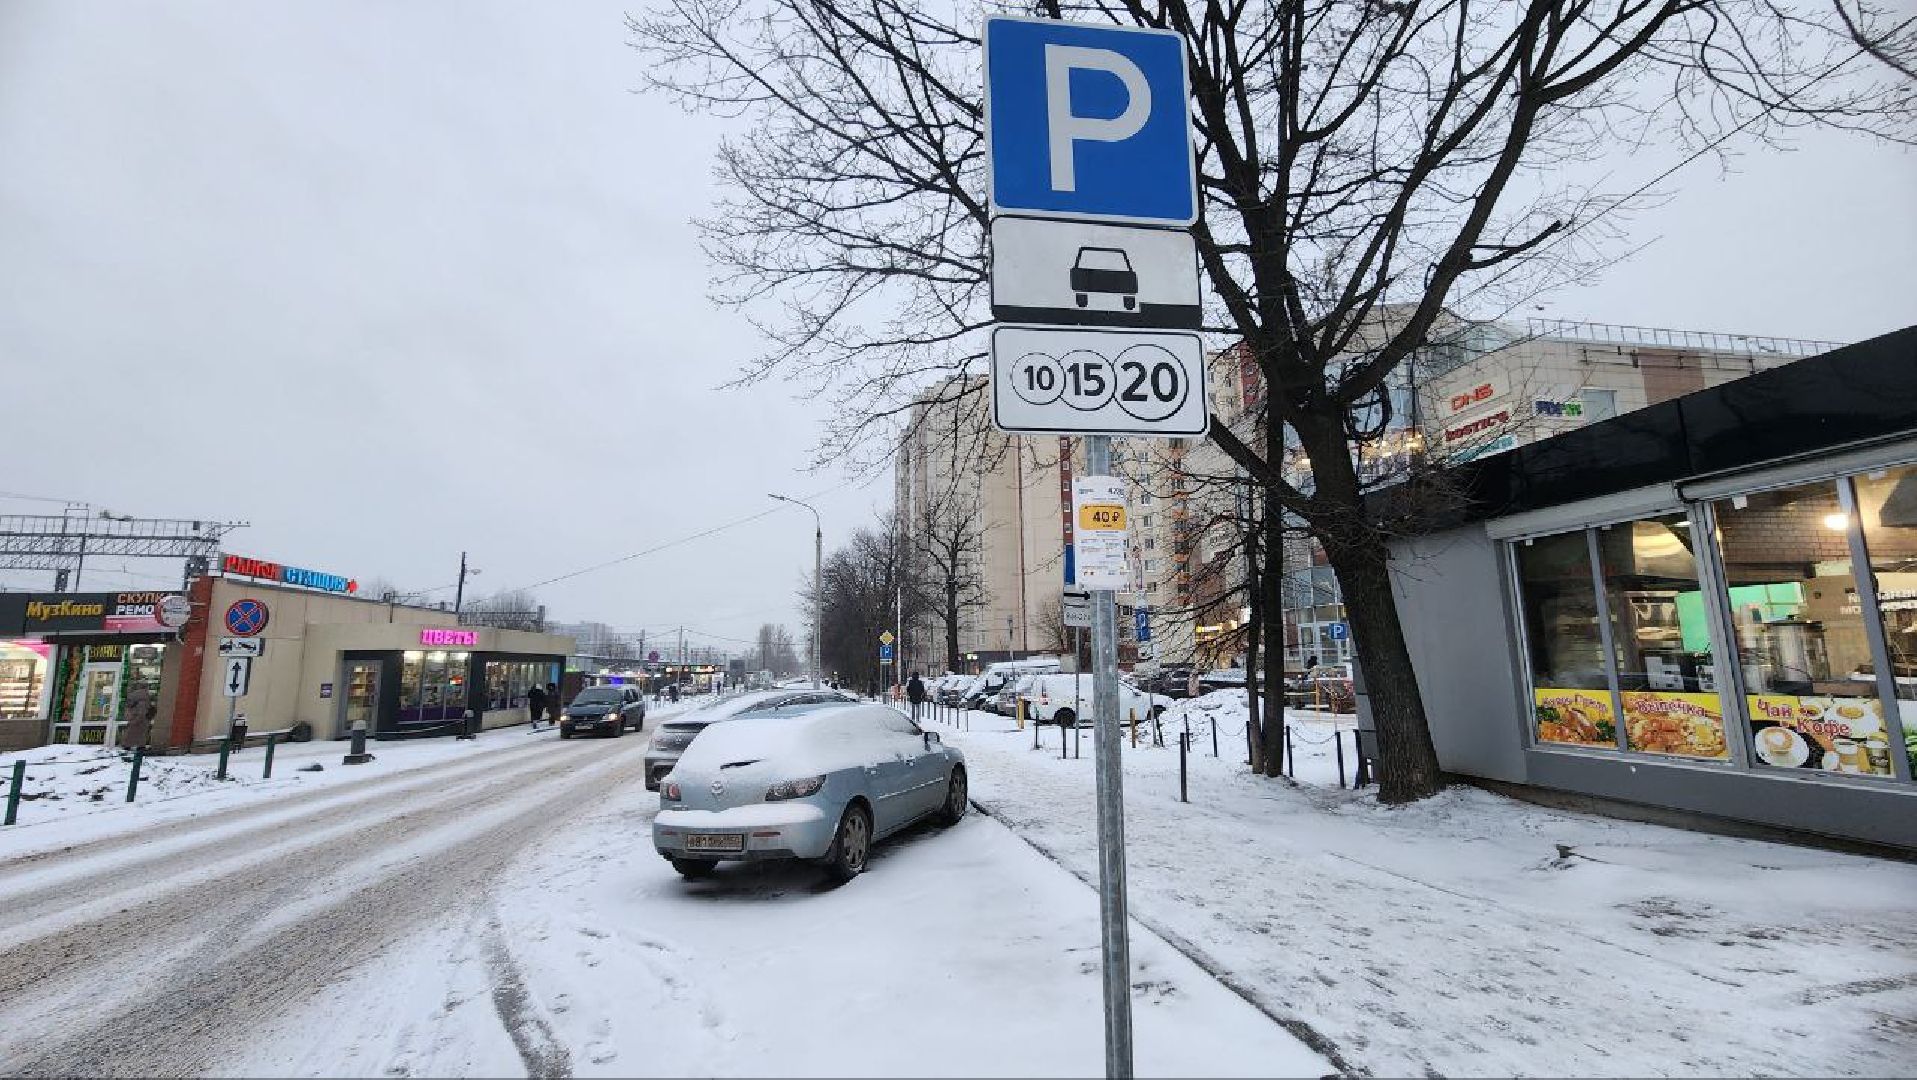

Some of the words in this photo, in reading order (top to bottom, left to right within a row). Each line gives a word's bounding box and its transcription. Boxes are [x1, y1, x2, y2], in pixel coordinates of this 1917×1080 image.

[1045, 43, 1152, 192] P
[1024, 365, 1055, 391] 10
[1067, 362, 1106, 397] 15
[1121, 361, 1179, 402] 20
[1092, 511, 1110, 523] 40
[421, 629, 479, 646] ЦВЕТЫ
[1334, 624, 1344, 639] P
[1757, 698, 1793, 717] Чай
[1797, 718, 1850, 737] Кофе
